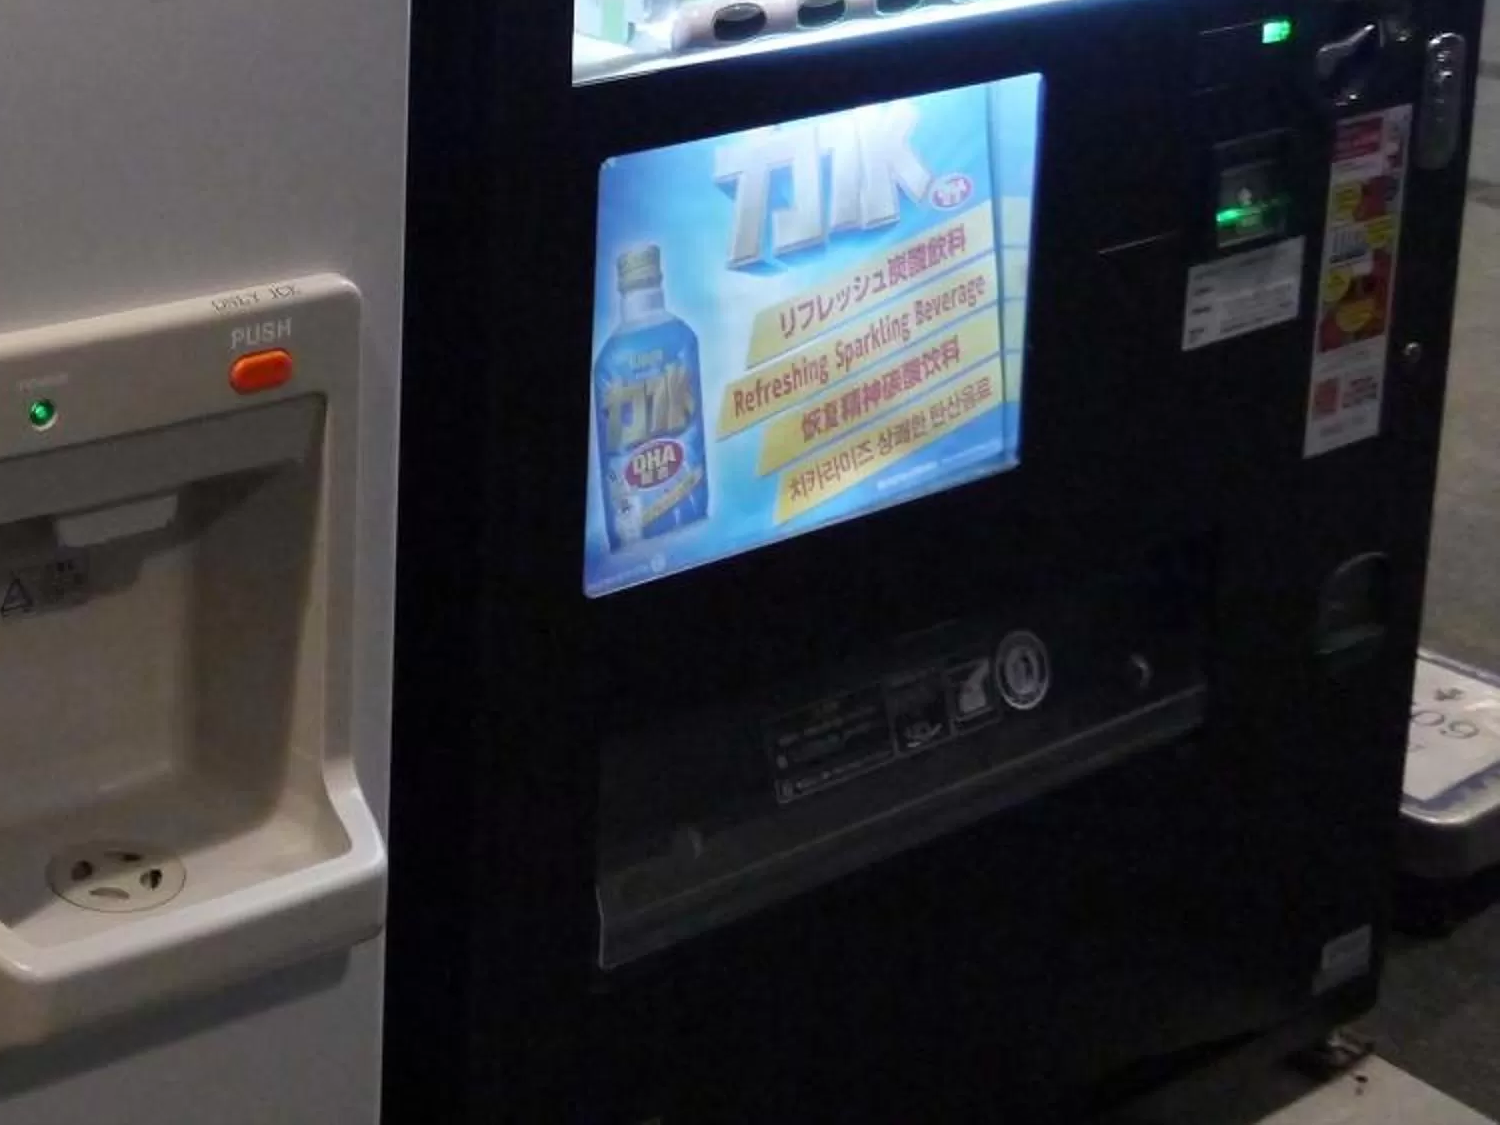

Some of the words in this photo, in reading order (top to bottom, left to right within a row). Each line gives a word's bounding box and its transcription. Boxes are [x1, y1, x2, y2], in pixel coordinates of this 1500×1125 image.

[230, 316, 293, 350] PUSH
[732, 354, 829, 420] Refreshing
[835, 312, 912, 373] Sparkling
[914, 274, 987, 327] Beverage
[632, 443, 677, 474] DHA
